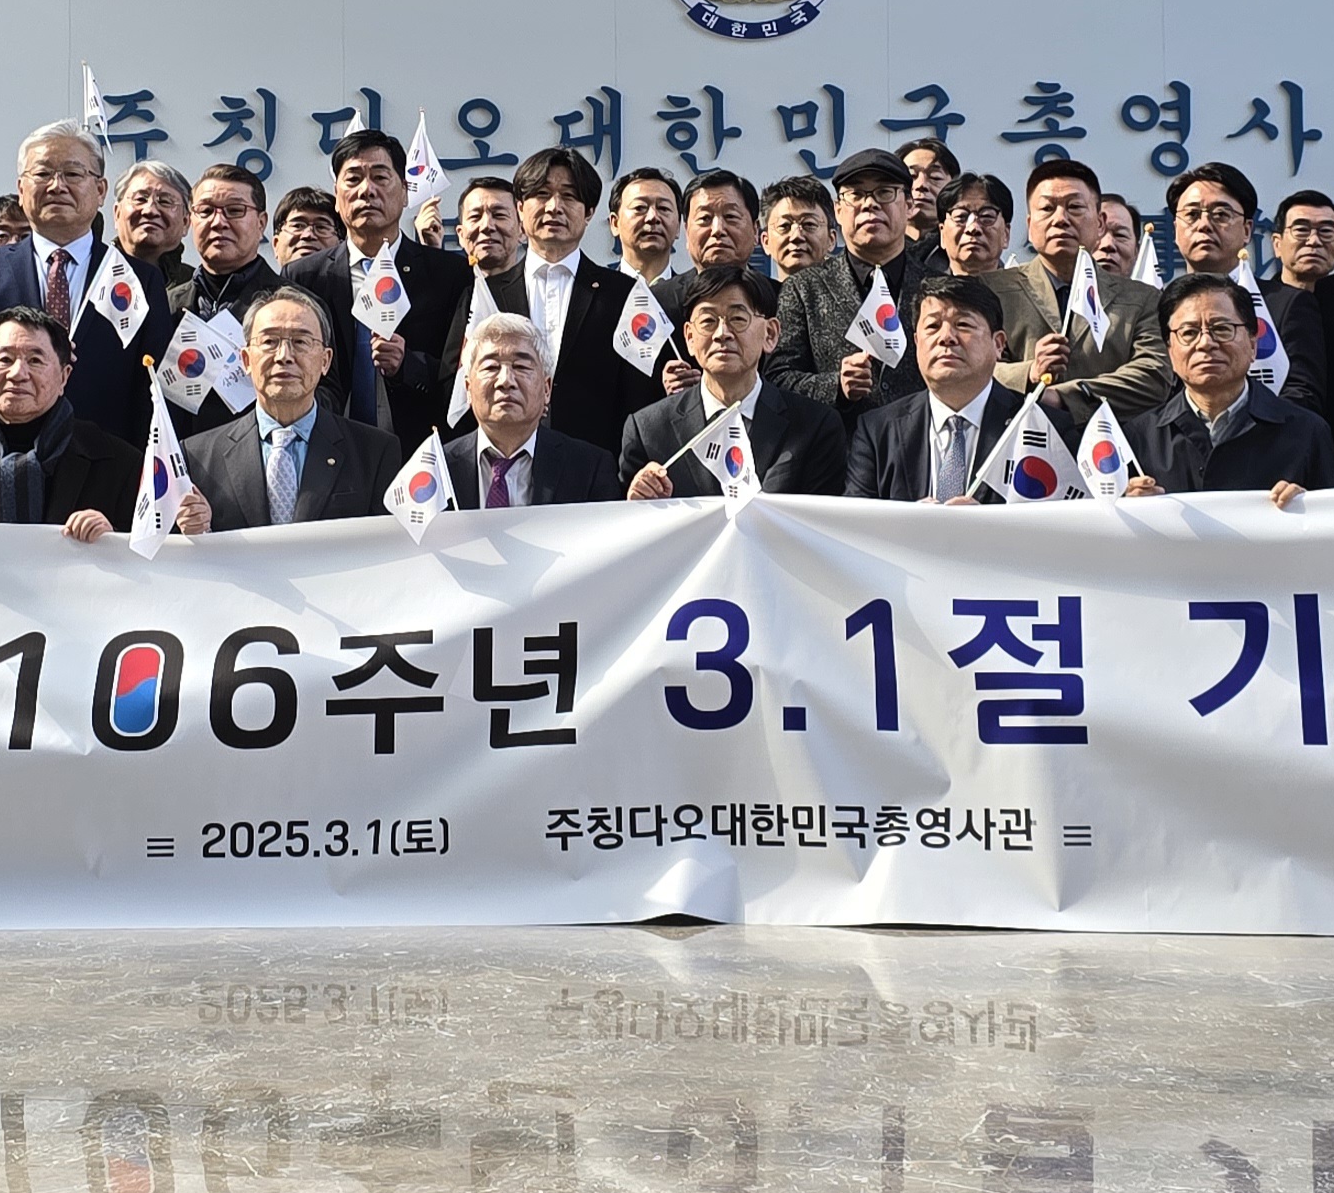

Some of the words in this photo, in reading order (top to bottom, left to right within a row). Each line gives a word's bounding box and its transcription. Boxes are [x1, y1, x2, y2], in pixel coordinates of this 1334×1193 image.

[700, 9, 809, 38] 대한민국
[663, 595, 1090, 746] 3.1절
[200, 814, 451, 859] 2025.3.1(토)
[544, 803, 1037, 852] 주칭다오대한민국총영사관
